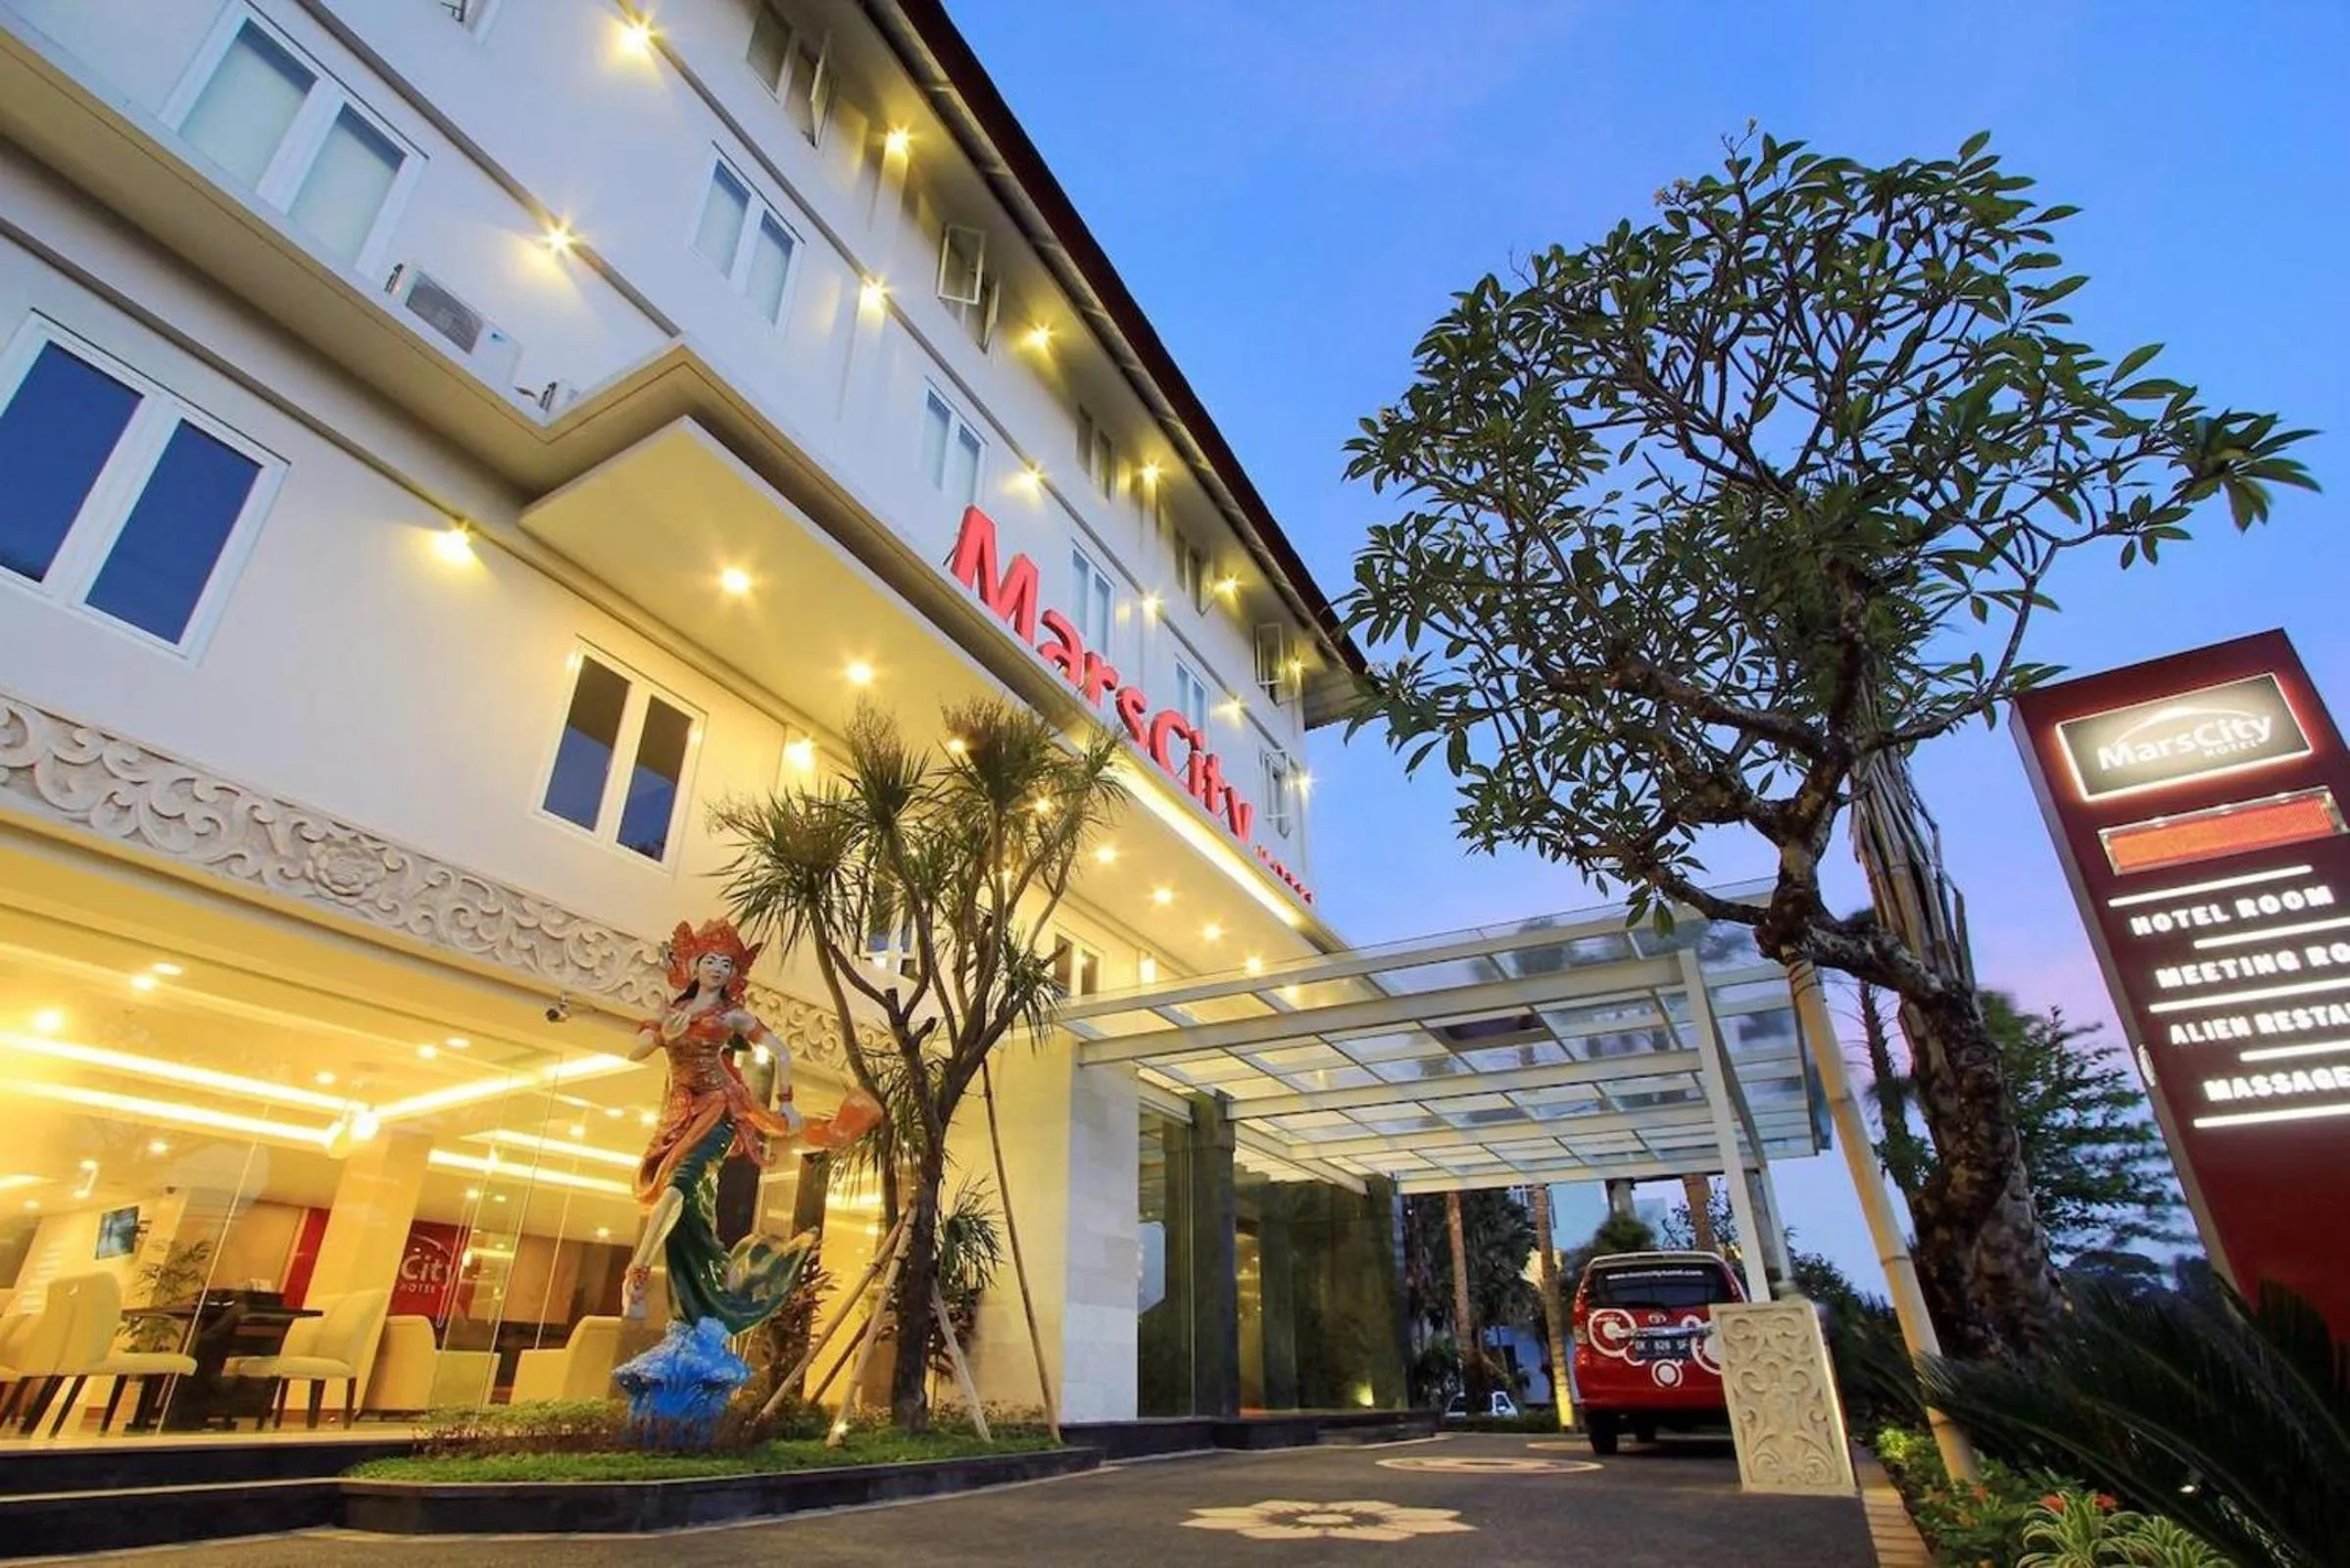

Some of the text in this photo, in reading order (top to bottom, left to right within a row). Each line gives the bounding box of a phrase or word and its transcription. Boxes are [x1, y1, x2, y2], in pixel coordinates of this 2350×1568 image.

[951, 503, 1252, 844] MarsCity
[2097, 715, 2271, 770] MarsCity
[2130, 885, 2335, 936] HOTEL ROOM
[2156, 950, 2302, 989] MEETING
[2170, 1002, 2350, 1046] ALIEN RESTA
[2203, 1065, 2350, 1102] MASSAGE
